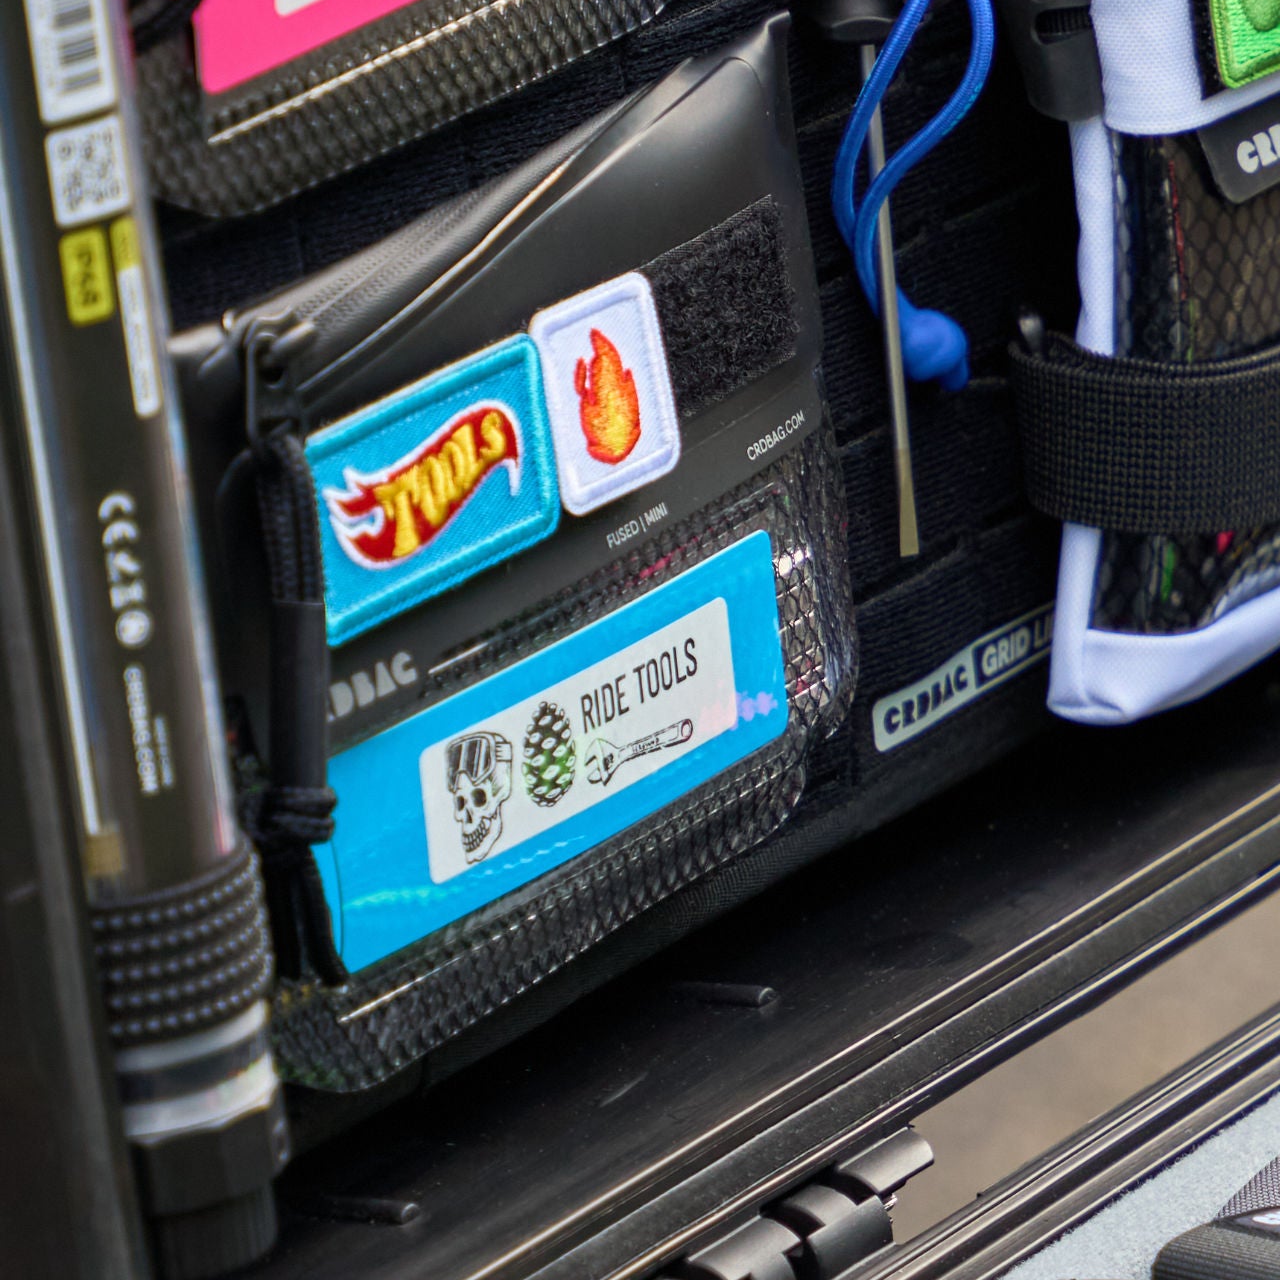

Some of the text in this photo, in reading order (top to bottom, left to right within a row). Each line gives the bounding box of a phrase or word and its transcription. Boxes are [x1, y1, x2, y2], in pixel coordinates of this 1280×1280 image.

[745, 409, 806, 462] CRDBAG.COM
[375, 410, 508, 559] TOOLS
[605, 519, 640, 550] FUSED
[643, 501, 669, 527] MINI
[981, 626, 1032, 677] GRID
[579, 636, 699, 736] RIDE TOOLS
